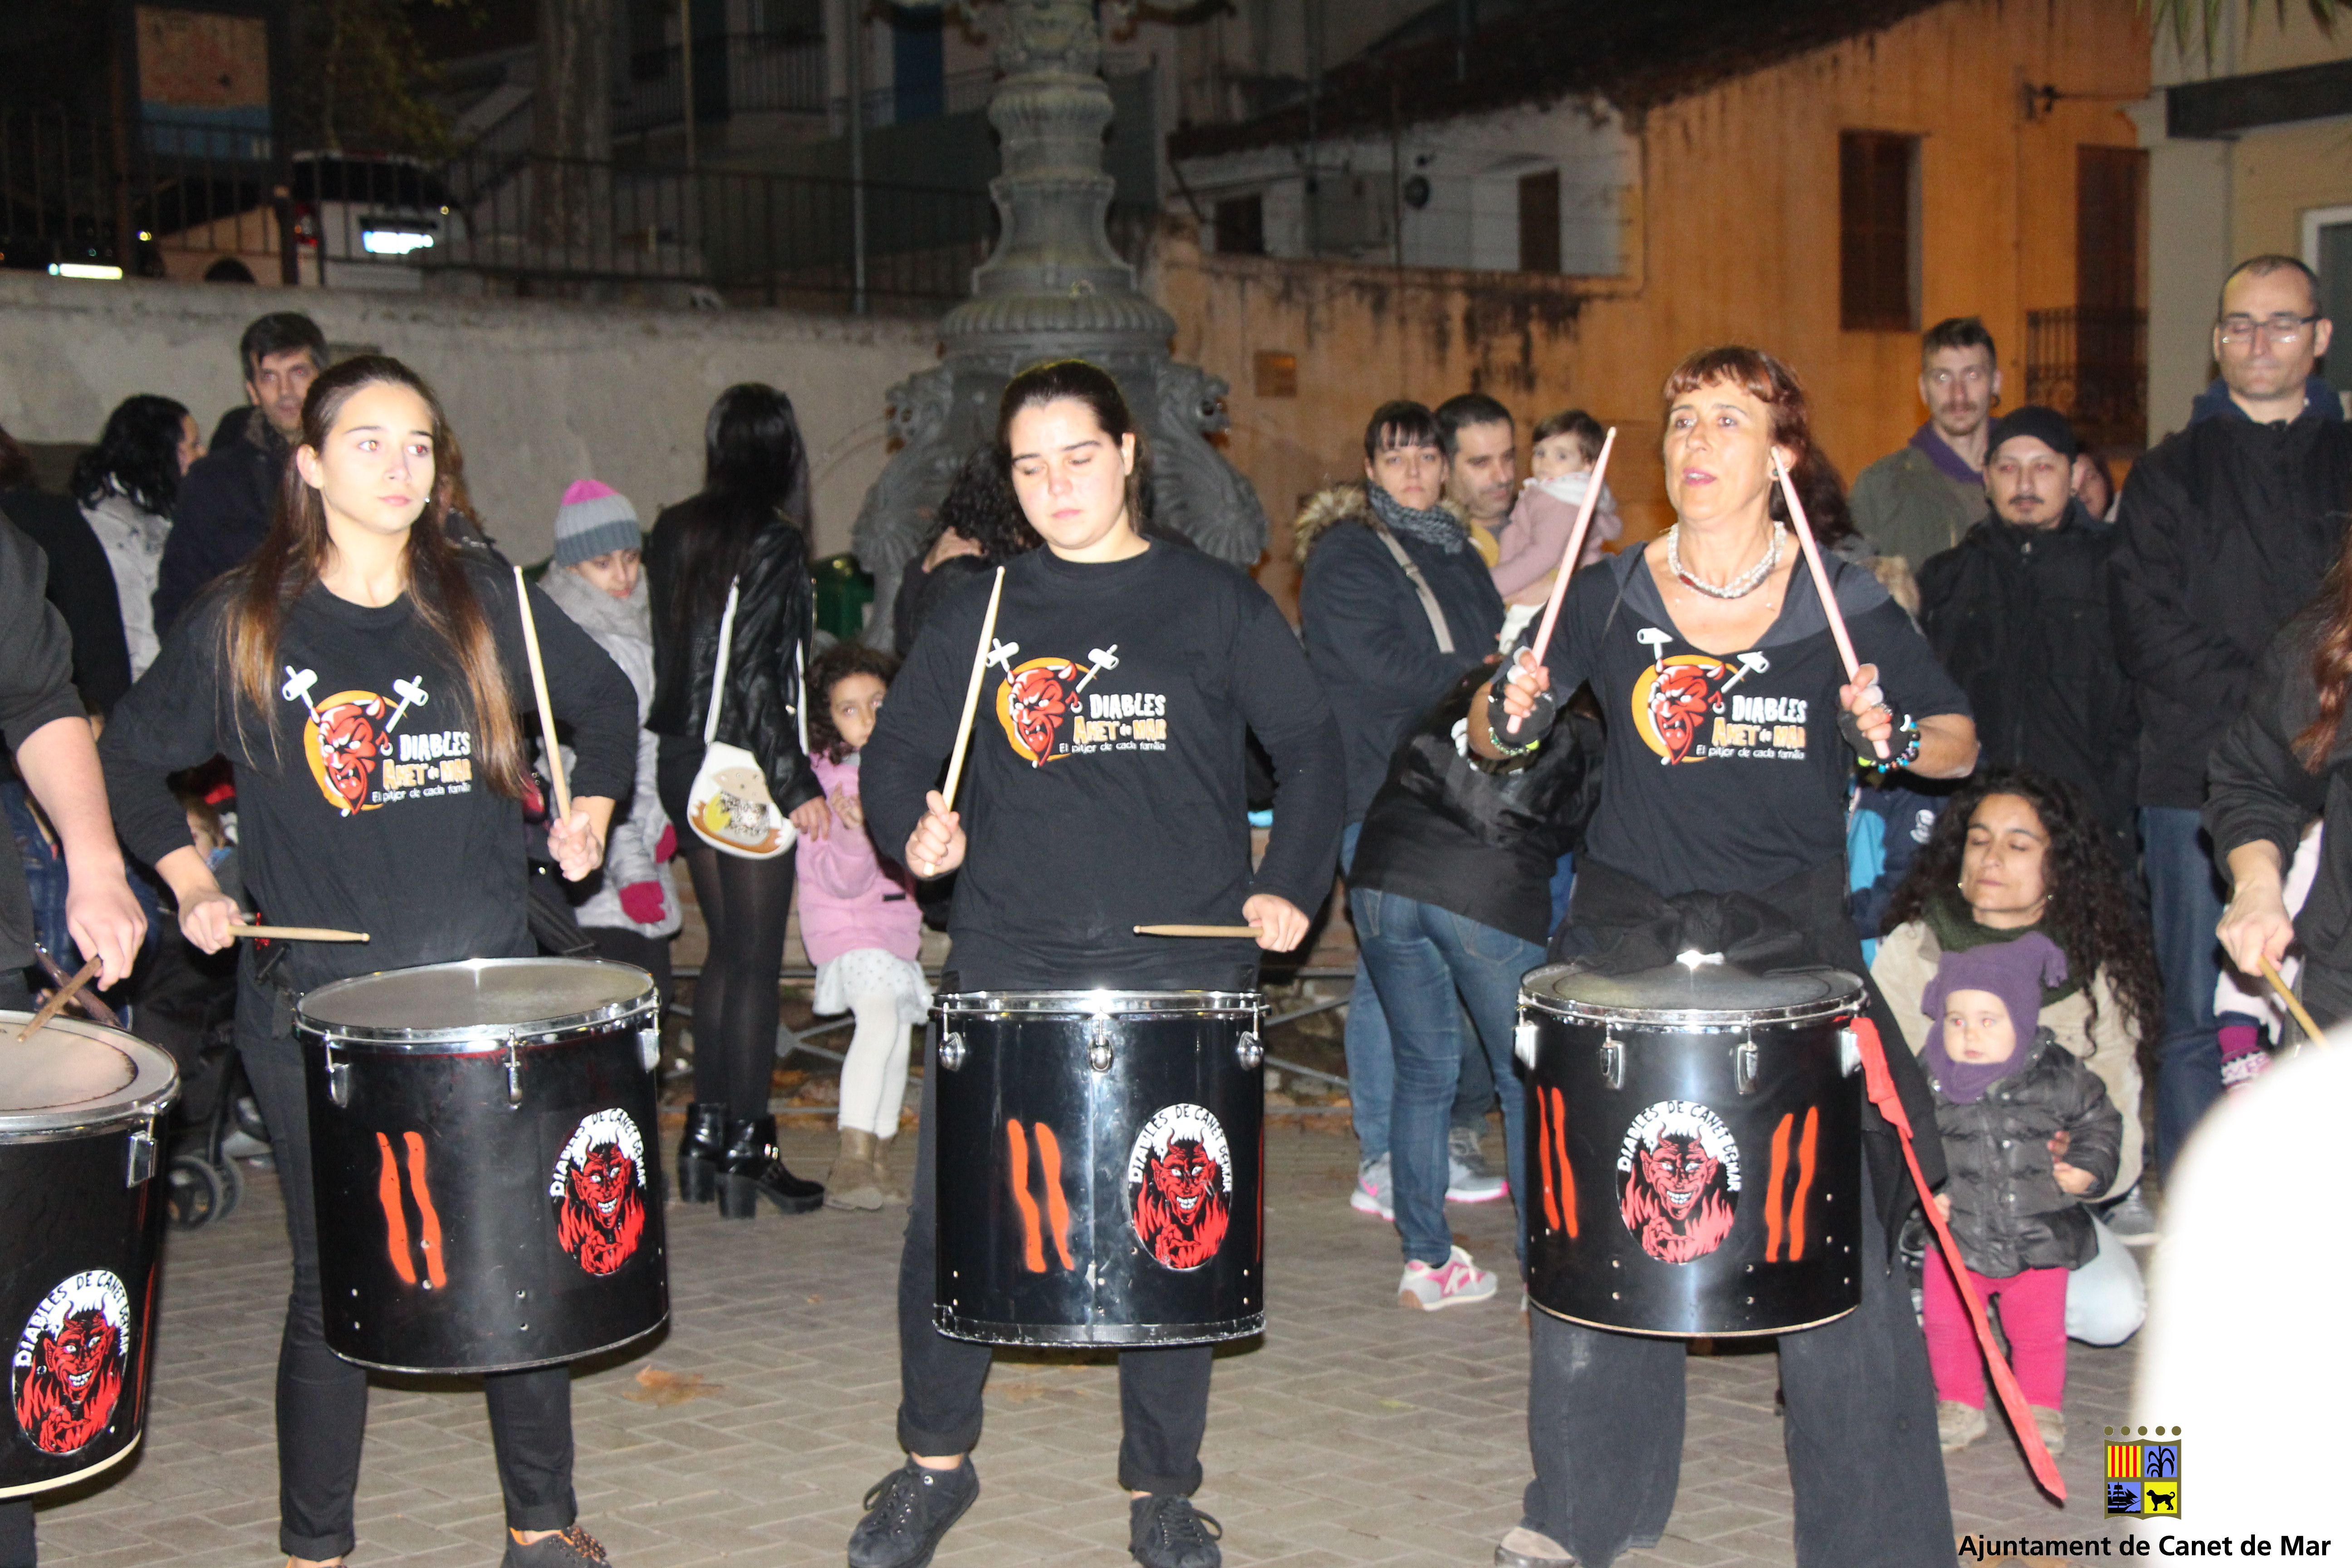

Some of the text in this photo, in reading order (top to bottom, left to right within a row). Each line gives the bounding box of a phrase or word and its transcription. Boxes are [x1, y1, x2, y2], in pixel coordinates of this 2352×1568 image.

[1089, 693, 1166, 720] DIABLES
[1731, 695, 1808, 724] DIABLES
[1119, 723, 1132, 736] de
[1132, 718, 1167, 741] MAR
[1759, 728, 1773, 742] de
[1773, 725, 1806, 750] MAR
[399, 731, 470, 762] DIABLES
[1059, 743, 1069, 753] El
[1072, 744, 1097, 754] pitjor
[1100, 742, 1112, 751] de
[1116, 740, 1137, 750] cada
[1696, 745, 1706, 755] El
[1708, 747, 1735, 758] pitjor
[1737, 748, 1750, 758] de
[1753, 748, 1775, 758] cada
[427, 765, 440, 780] de
[439, 758, 473, 784] MAR
[372, 791, 382, 803] El
[382, 790, 407, 804] pitjor
[409, 788, 421, 799] de
[423, 784, 446, 797] cada
[592, 1112, 605, 1125] DE
[1128, 1112, 1168, 1183] DIABLES
[1175, 1105, 1190, 1119] DE
[1194, 1107, 1224, 1141] CANET
[1617, 1106, 1659, 1173] DIABLES
[1667, 1101, 1685, 1114] DE
[1690, 1105, 1730, 1139] CANET
[13, 1284, 68, 1368] DIABLES
[76, 1272, 93, 1290] DE
[97, 1271, 125, 1304] CANET
